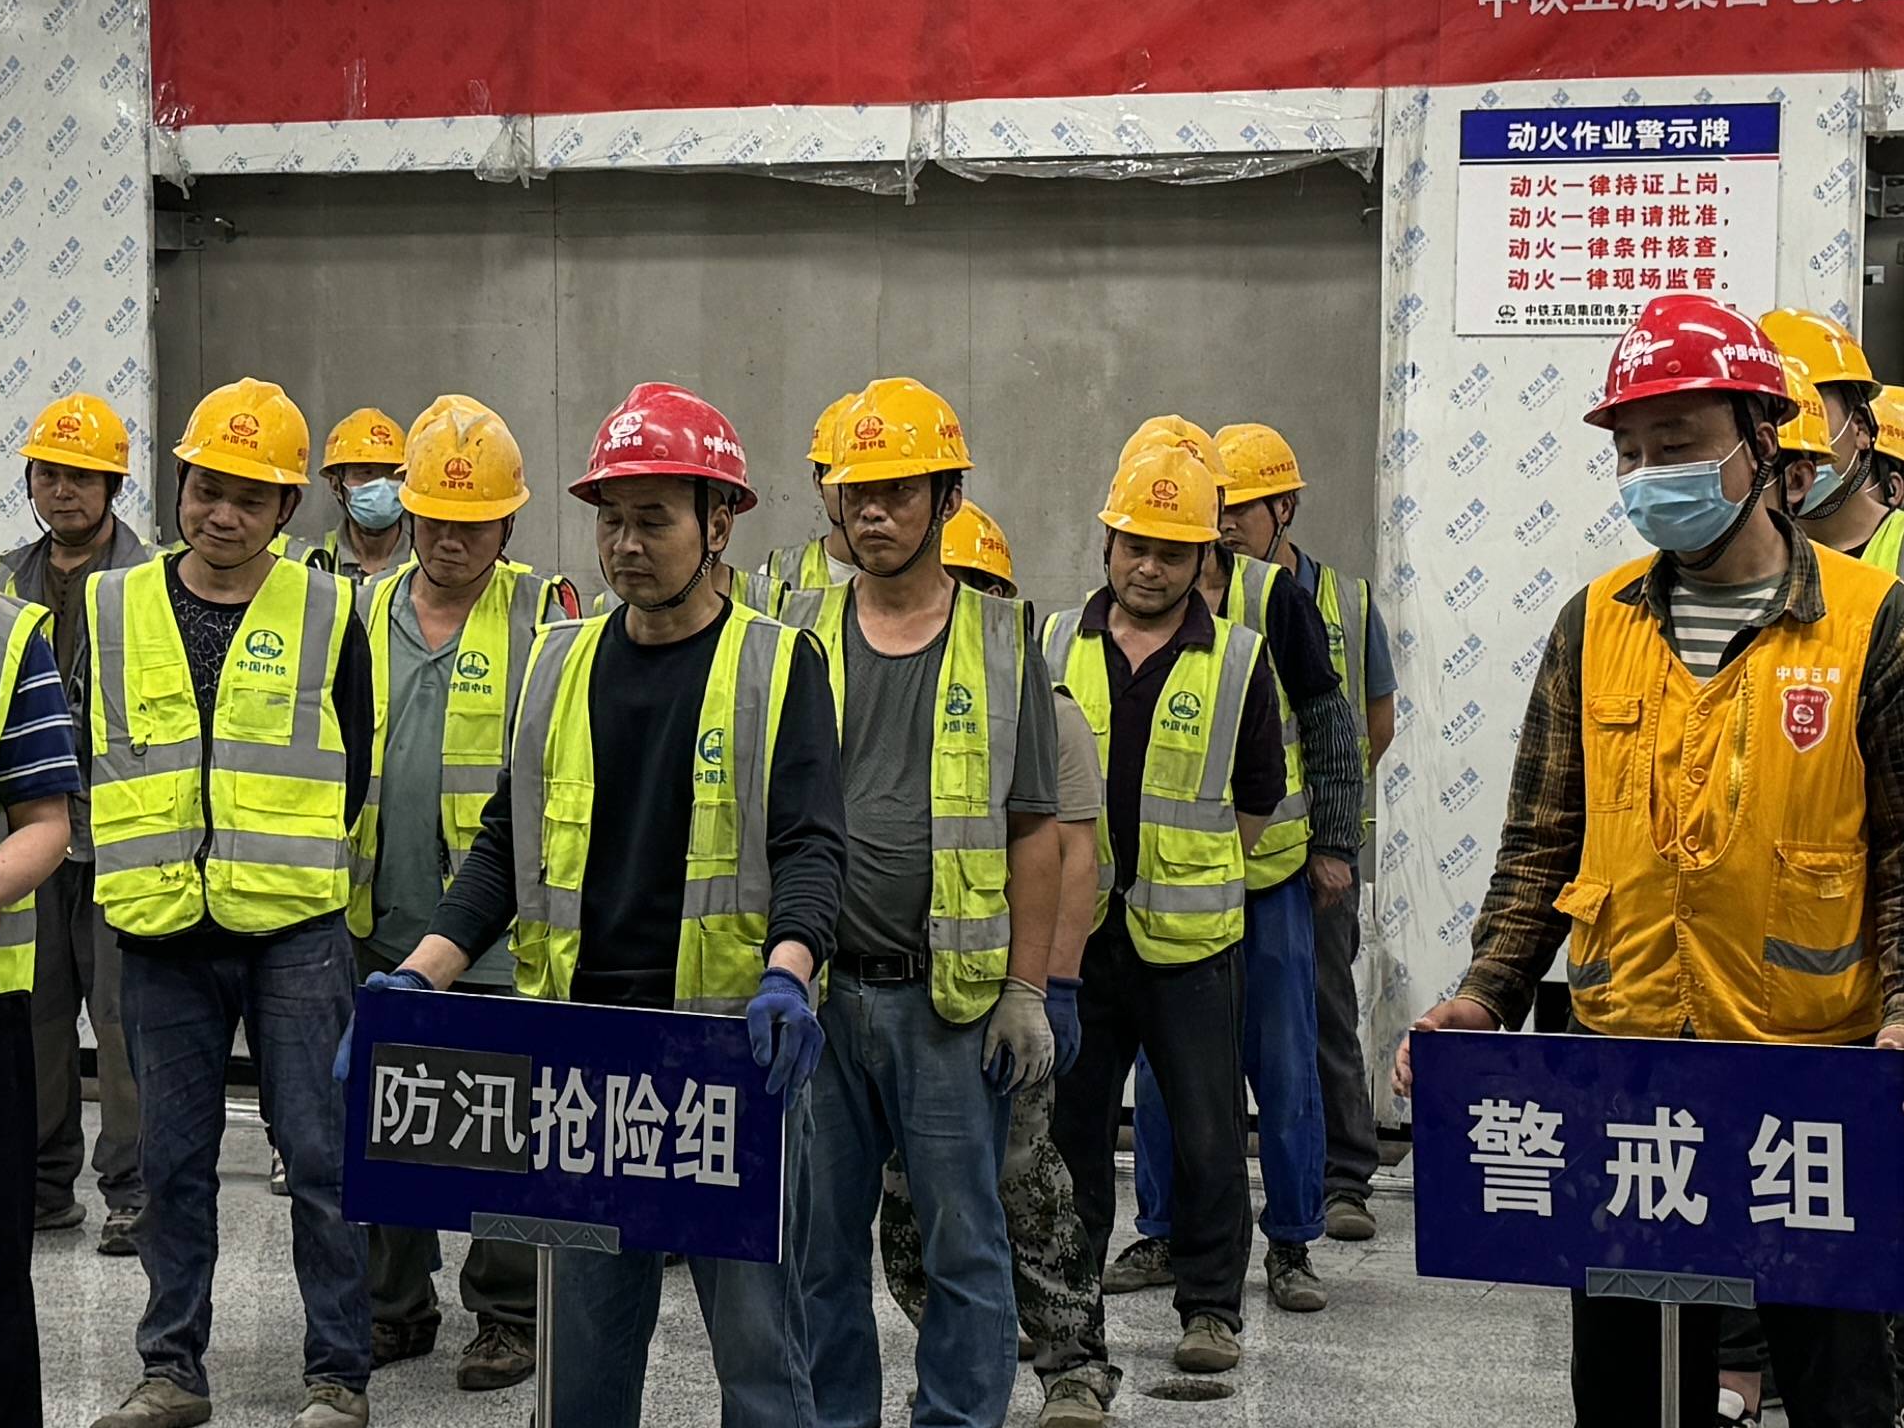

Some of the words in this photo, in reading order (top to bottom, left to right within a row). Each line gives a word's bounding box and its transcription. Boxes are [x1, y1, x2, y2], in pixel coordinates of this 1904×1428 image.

[1507, 117, 1731, 152] 动火作业警示牌
[236, 659, 287, 677] 中国中铁
[371, 1063, 740, 1188] 防汛抢险组
[1467, 1098, 1856, 1232] 警戒组
